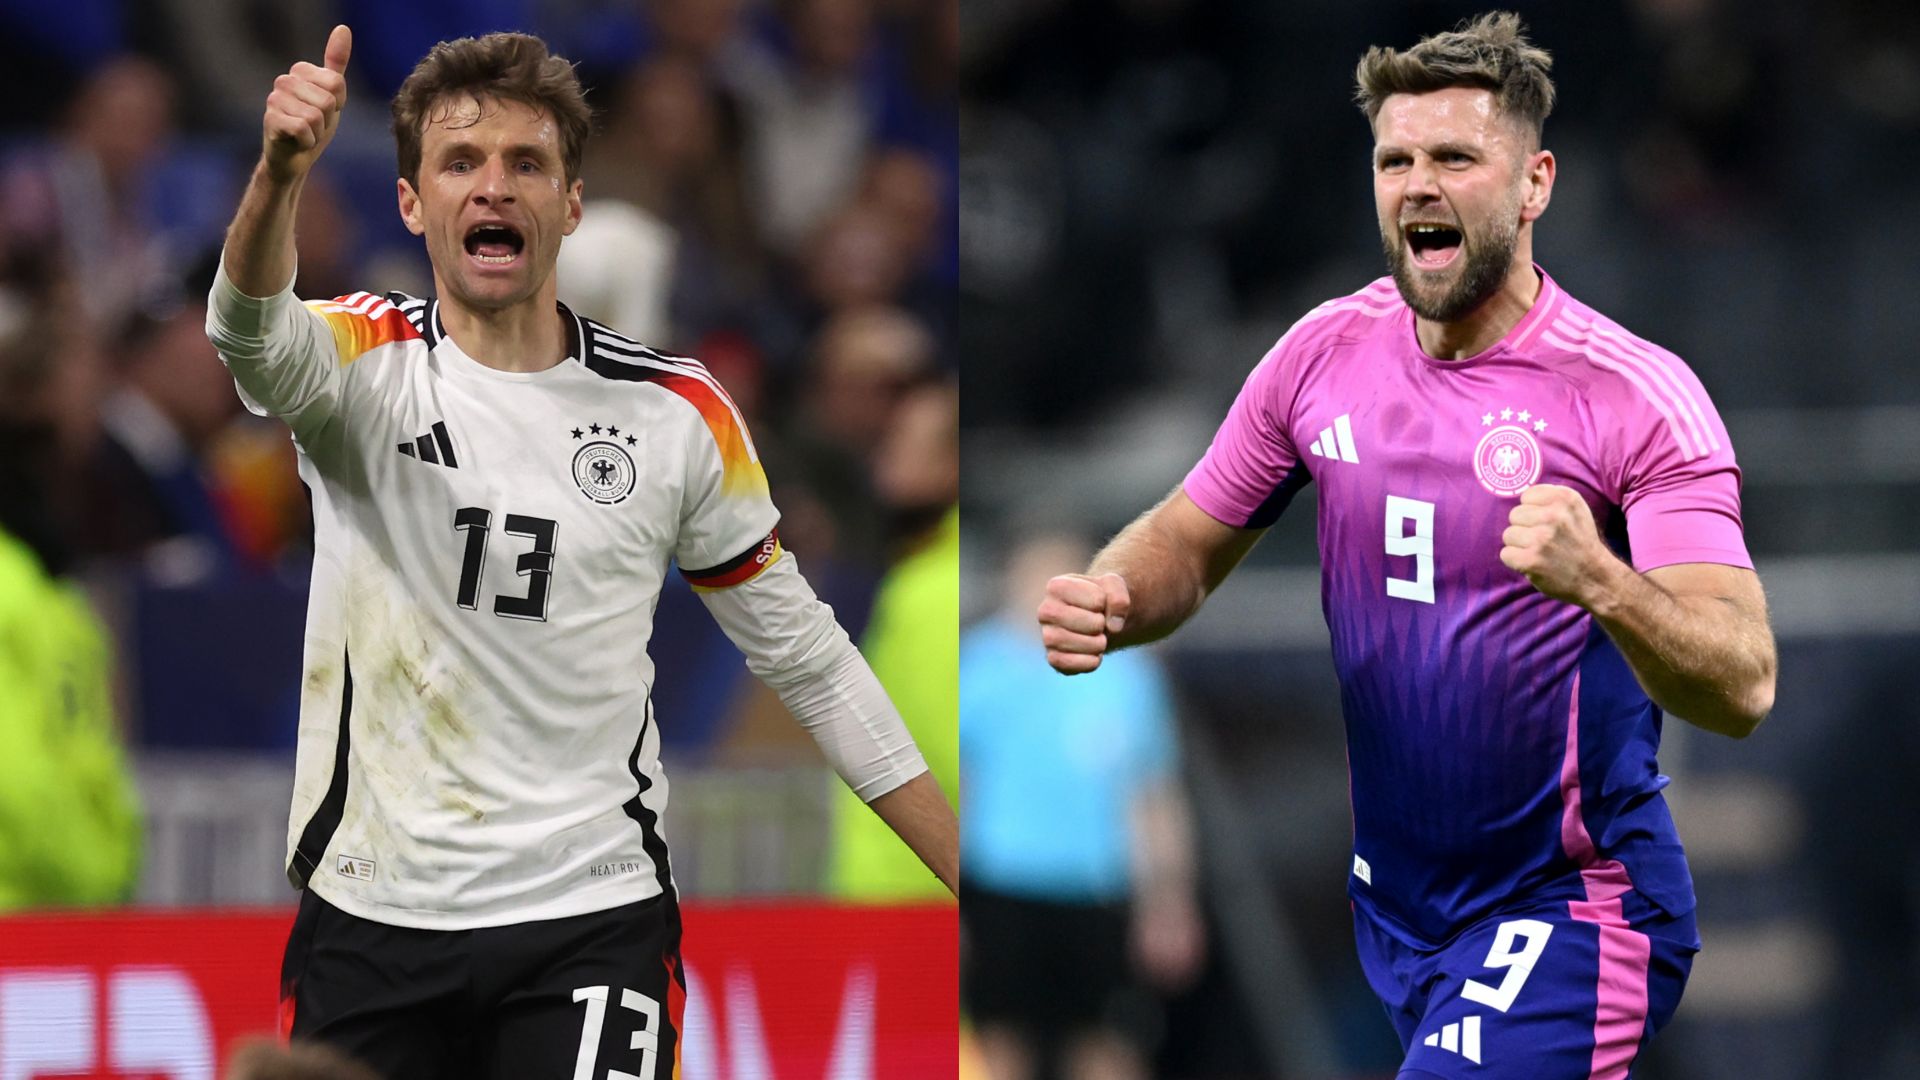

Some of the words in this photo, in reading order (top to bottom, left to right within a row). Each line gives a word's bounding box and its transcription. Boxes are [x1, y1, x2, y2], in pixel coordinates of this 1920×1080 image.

[585, 449, 622, 463] DEUTSCHER
[1490, 434, 1527, 449] DEUTSCHER
[454, 507, 559, 622] 13
[1384, 494, 1435, 604] 9
[1460, 919, 1554, 1013] 9
[573, 985, 660, 1080] 13
